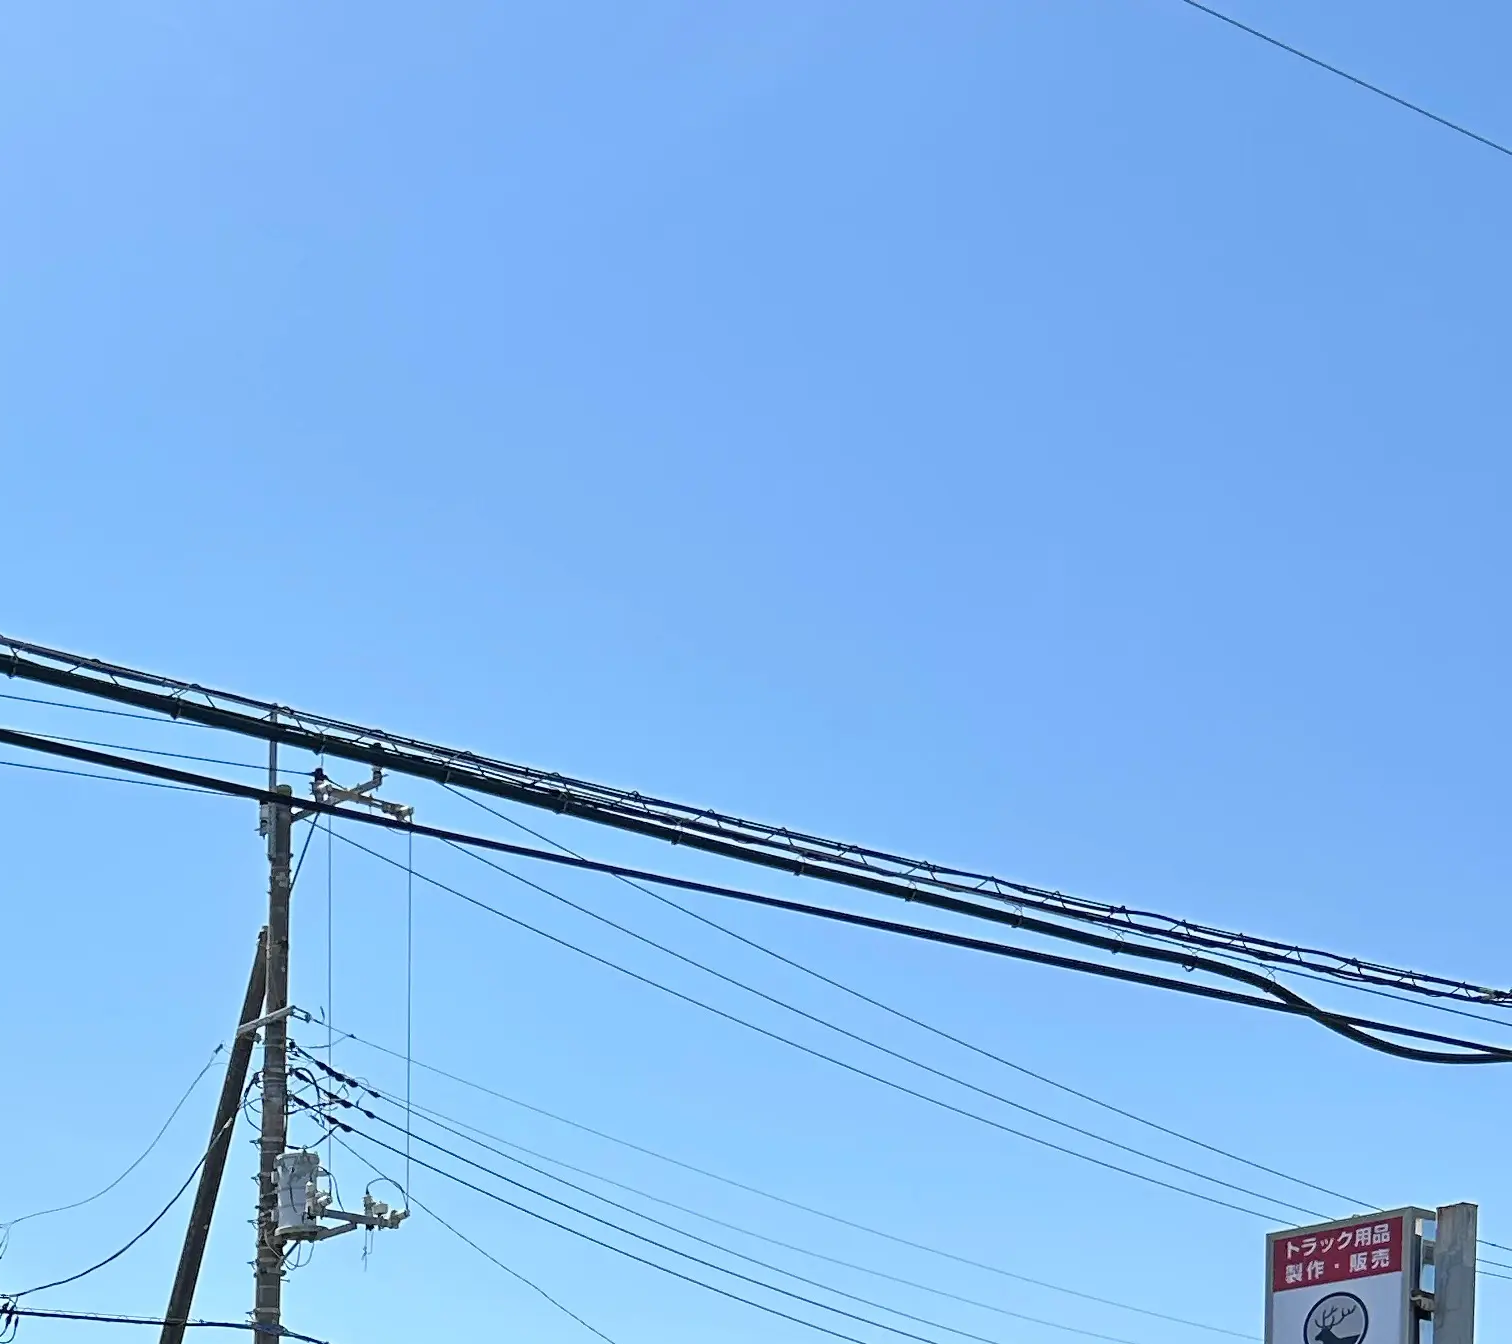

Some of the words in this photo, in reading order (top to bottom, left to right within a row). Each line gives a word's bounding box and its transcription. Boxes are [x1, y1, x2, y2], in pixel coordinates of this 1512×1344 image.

[1286, 1223, 1390, 1260] トラック用品
[1285, 1248, 1390, 1283] 製作・販売
